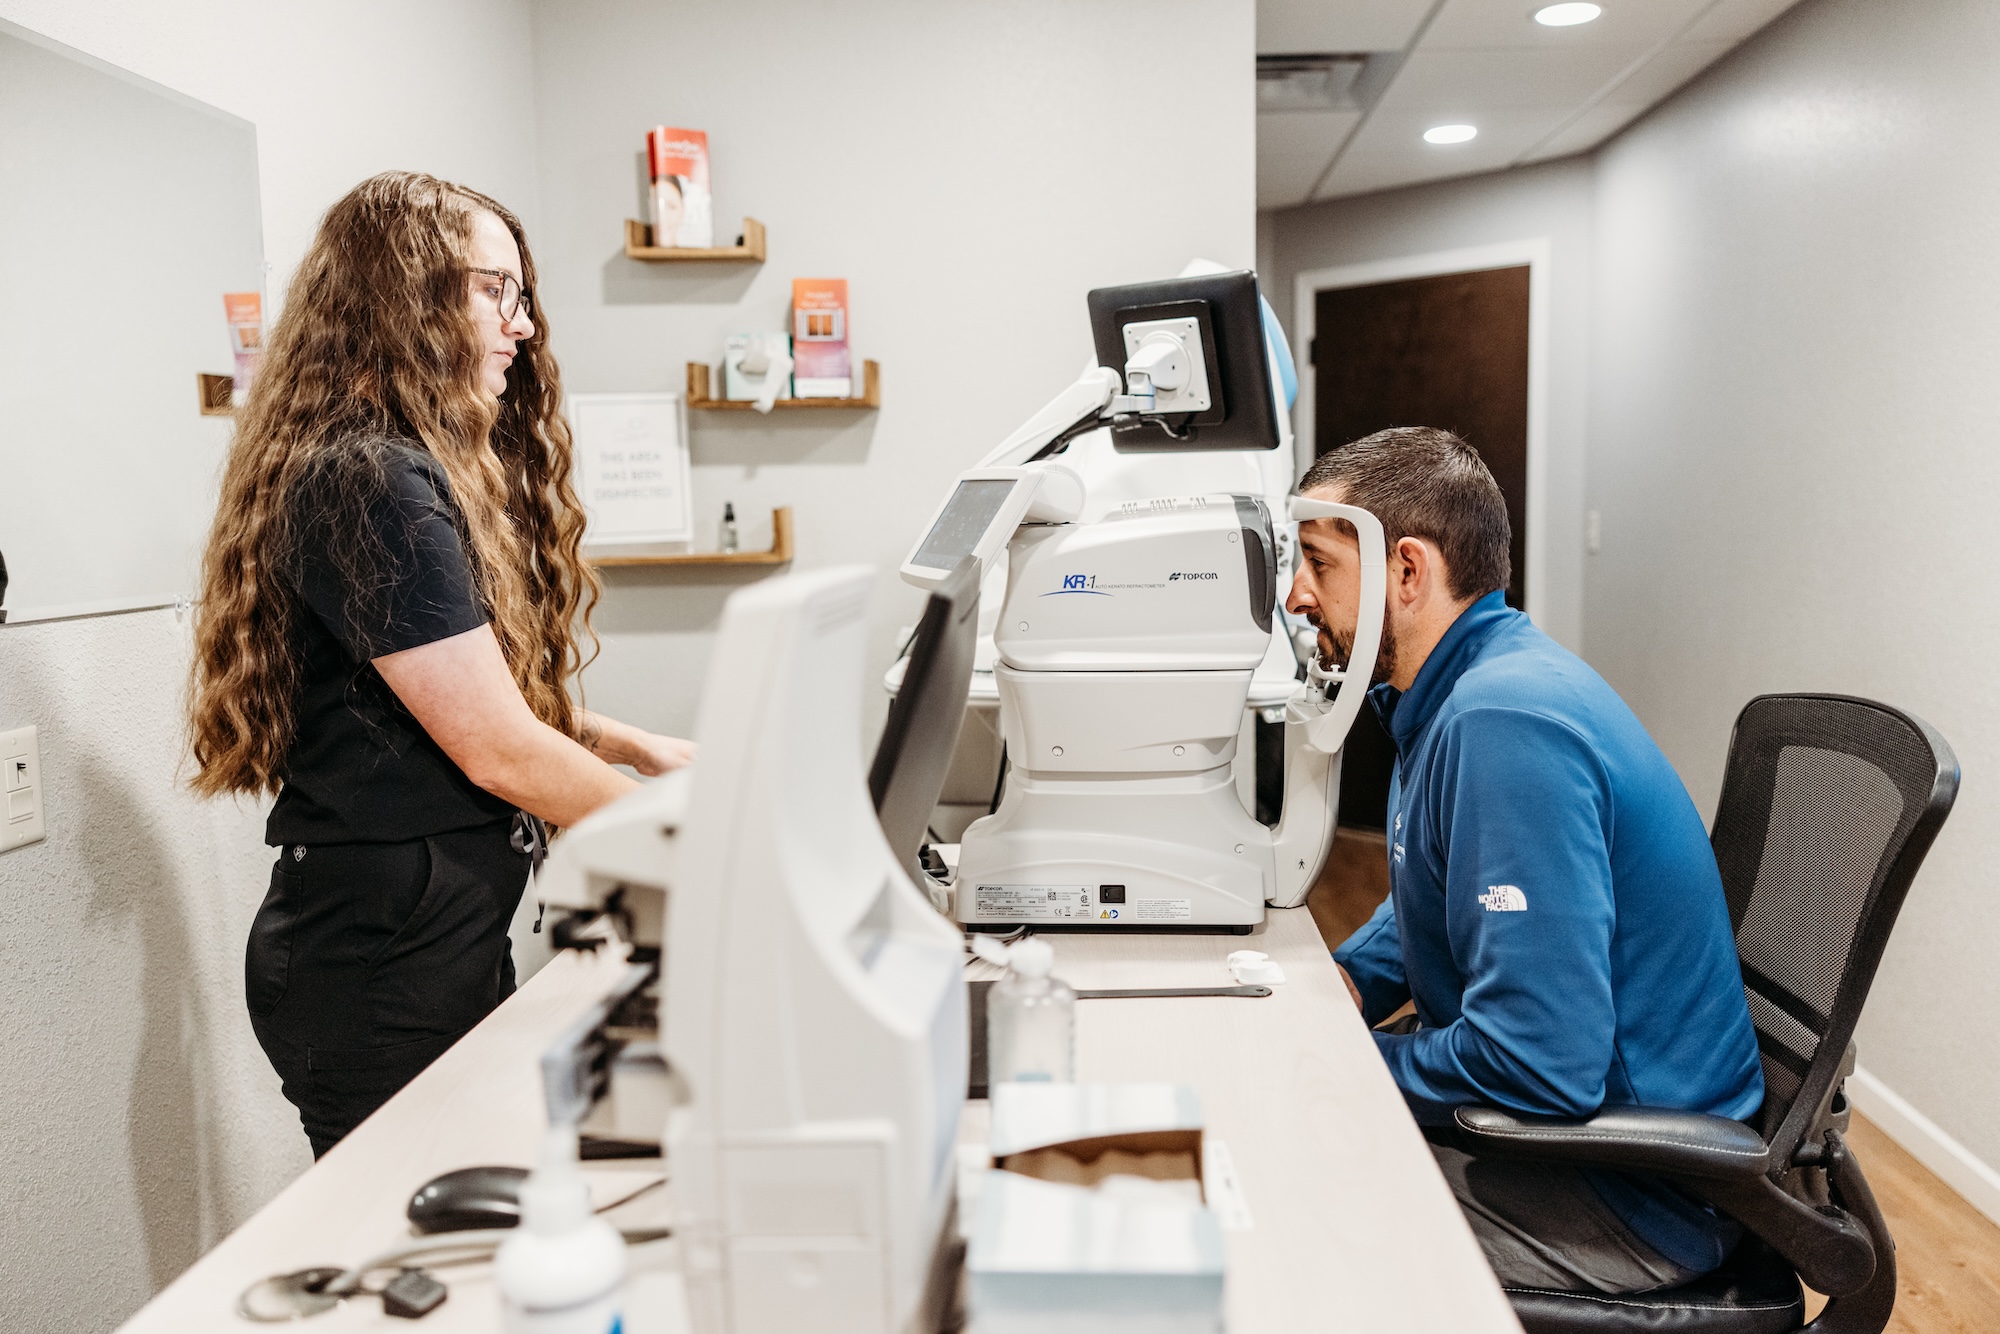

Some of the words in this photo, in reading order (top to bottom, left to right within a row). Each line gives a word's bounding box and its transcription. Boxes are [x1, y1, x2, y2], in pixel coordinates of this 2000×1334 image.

[1182, 572, 1218, 581] TOPCON
[1488, 885, 1507, 895] THE
[1478, 894, 1507, 904] NORTH
[1485, 902, 1509, 912] FACE
